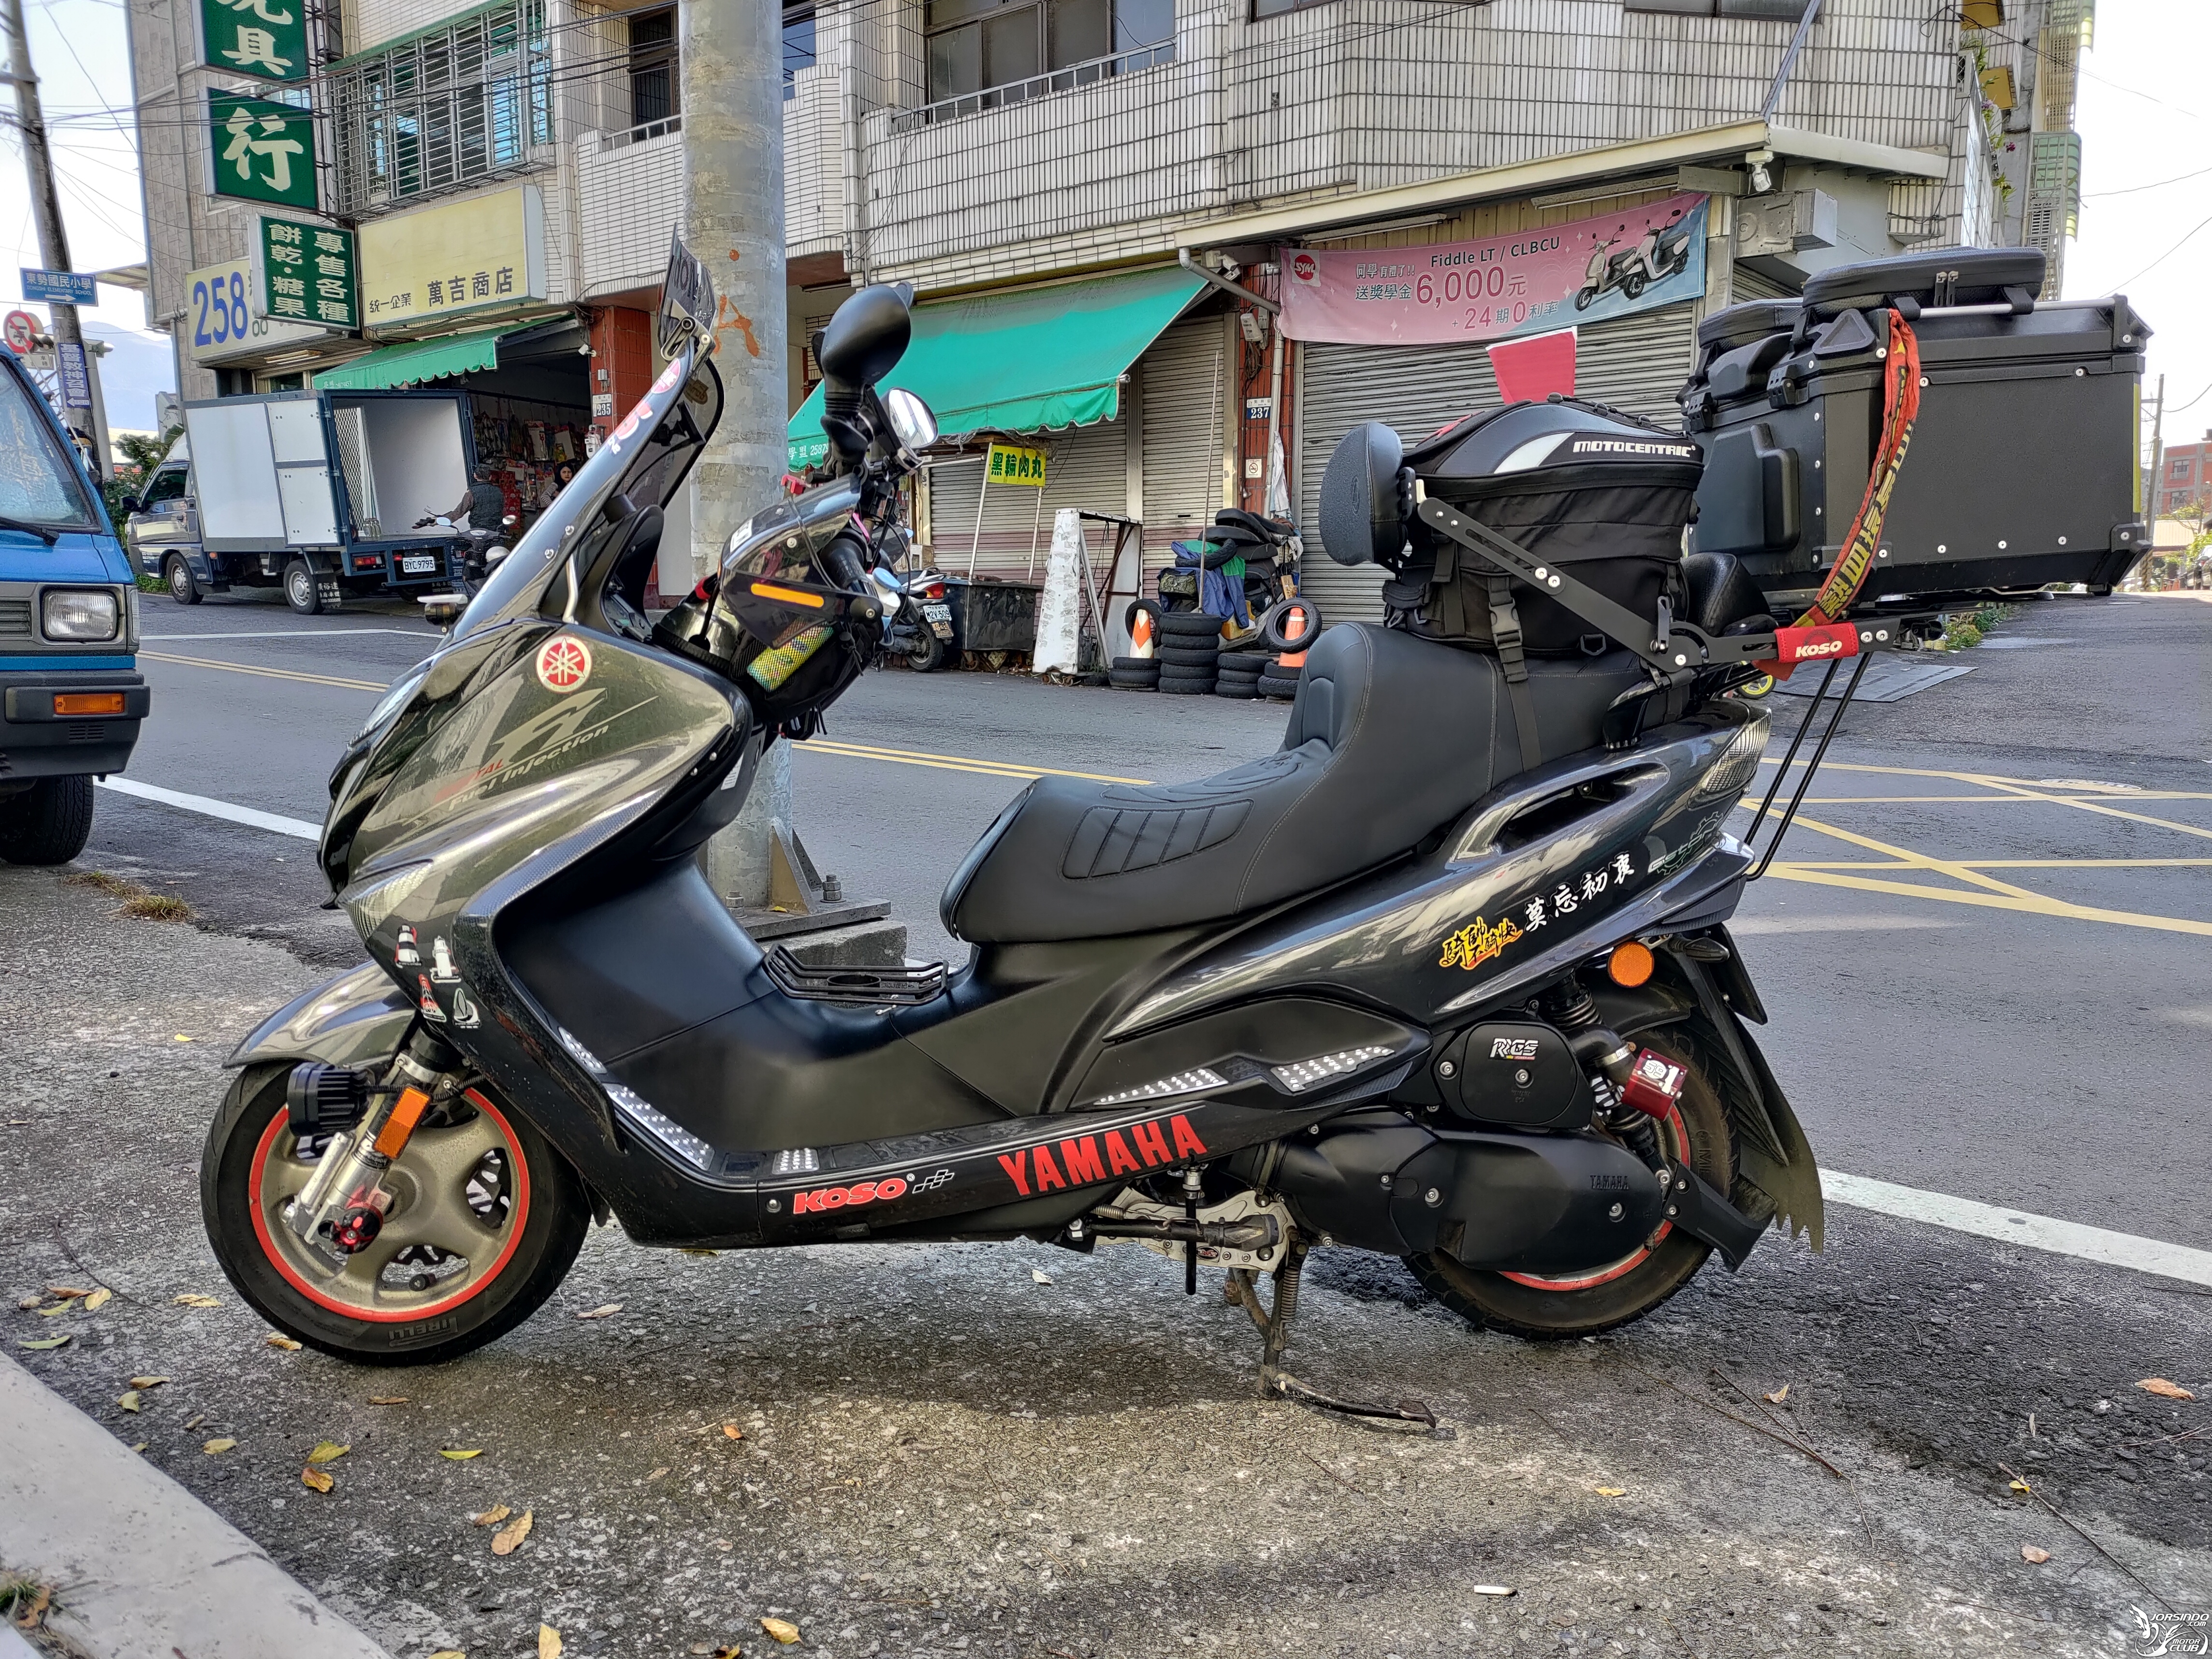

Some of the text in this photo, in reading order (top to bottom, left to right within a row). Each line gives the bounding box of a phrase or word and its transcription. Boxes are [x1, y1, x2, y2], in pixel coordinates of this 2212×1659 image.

[223, 107, 304, 192] 行
[1431, 251, 1475, 267] Fiddle
[1480, 248, 1496, 262] LT
[1511, 236, 1559, 257] CLBCU
[26, 273, 92, 290] 東勢國民小學
[314, 231, 349, 322] 專售各種
[1294, 262, 1316, 275] SYM
[427, 266, 513, 307] 萬吉商店
[1355, 283, 1412, 301] 送獎學金
[193, 271, 248, 348] 258
[369, 292, 411, 313] 統一企業
[60, 343, 86, 397] 基督教神召會
[597, 403, 611, 416] 235
[1251, 407, 1269, 419] 237
[991, 452, 1042, 479] 黑輪肉丸
[404, 560, 434, 570] BYC-9793
[1795, 640, 1842, 658] KOSO
[449, 776, 496, 812] Fuel
[502, 725, 610, 784] Injection
[997, 1114, 1208, 1196] YAMAHA
[793, 1178, 907, 1215] KOSO
[1590, 1175, 1630, 1191] YAMAHA
[389, 1316, 458, 1347] PIRELLI
